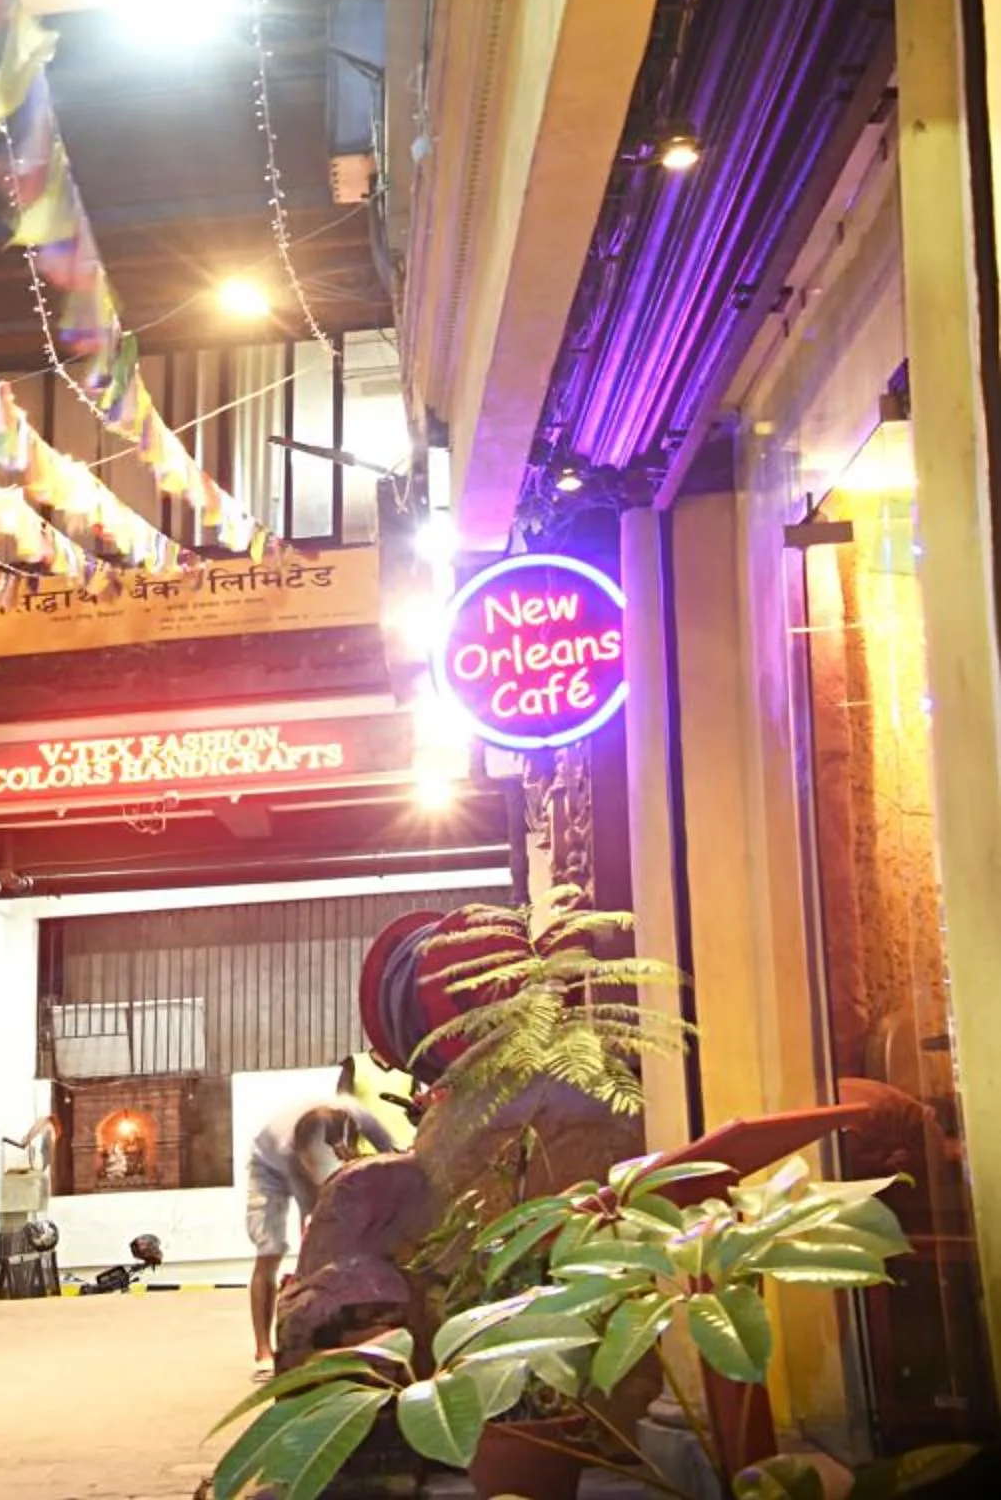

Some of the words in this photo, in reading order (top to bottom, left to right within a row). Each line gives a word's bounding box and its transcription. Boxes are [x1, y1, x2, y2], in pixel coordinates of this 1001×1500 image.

[207, 563, 336, 595] लिमिटेड
[483, 591, 579, 634] New
[453, 630, 622, 681] Orleans
[490, 667, 596, 718] Café
[118, 742, 344, 783] HANDICRAFTS
